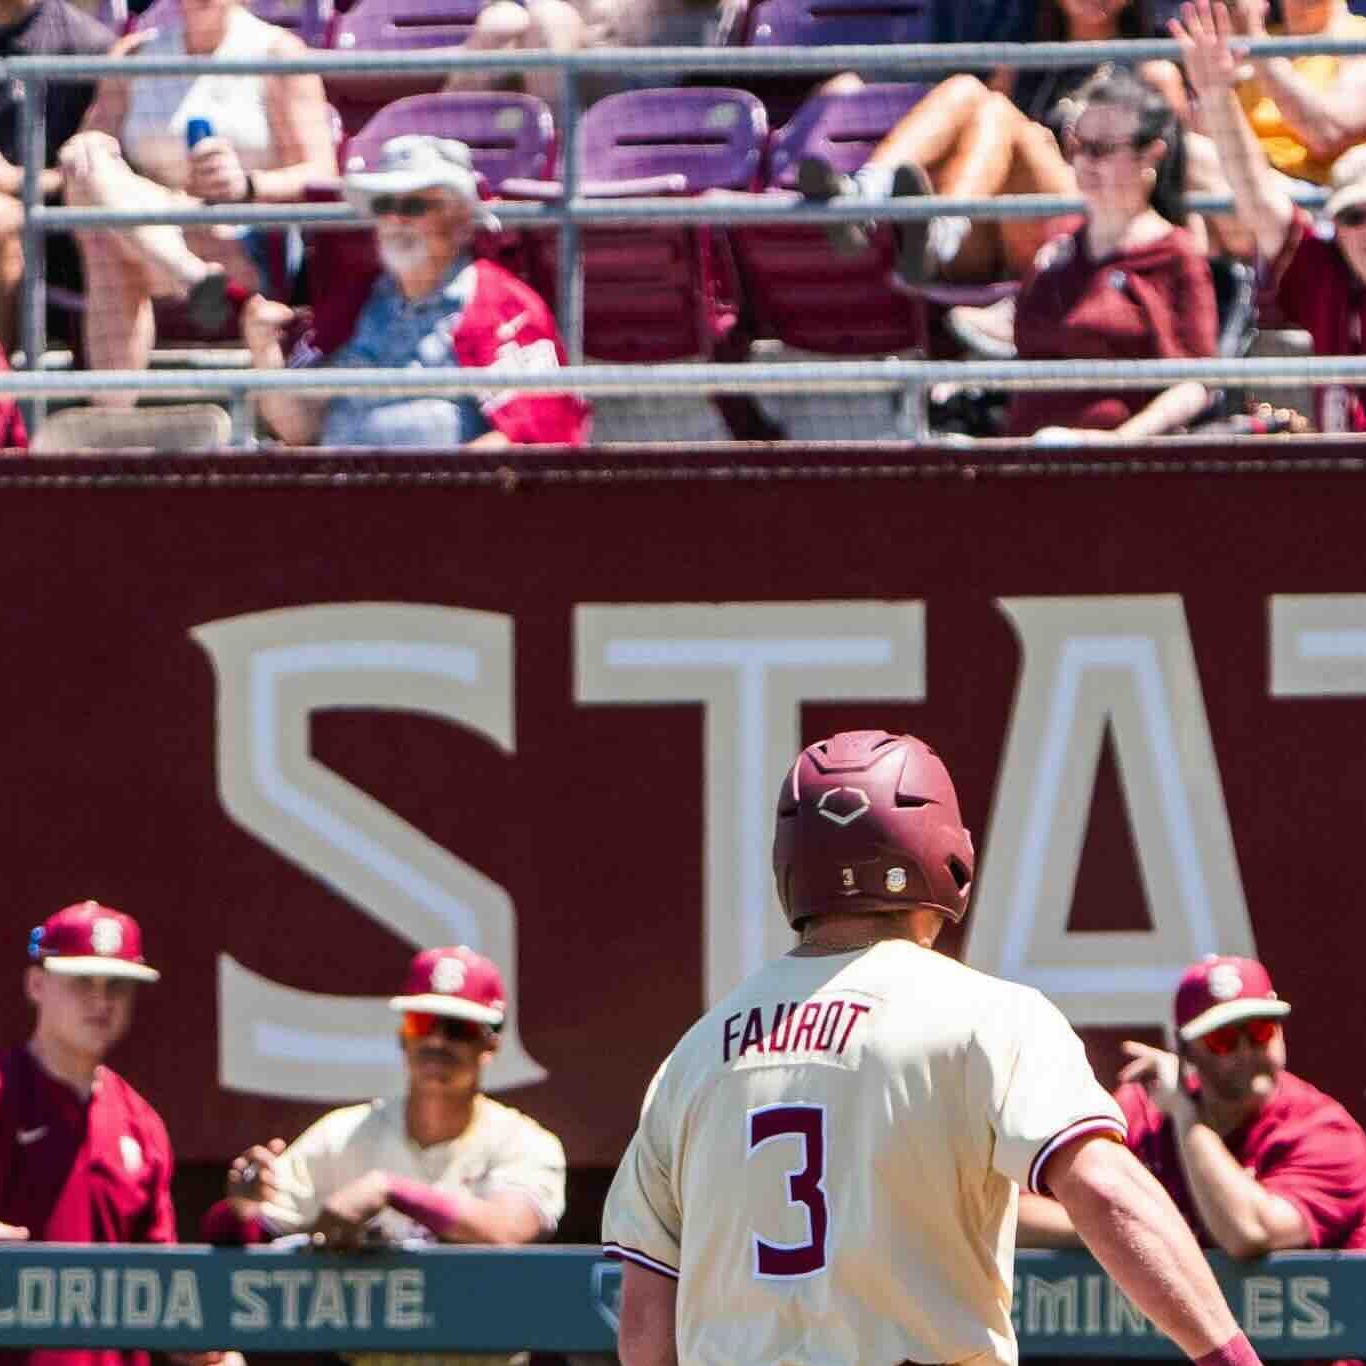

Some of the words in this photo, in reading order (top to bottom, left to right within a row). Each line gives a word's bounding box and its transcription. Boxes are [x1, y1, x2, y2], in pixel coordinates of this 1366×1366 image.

[722, 1000, 871, 1064] FAUROT
[746, 1102, 830, 1281] 3
[229, 1268, 425, 1330] STATE
